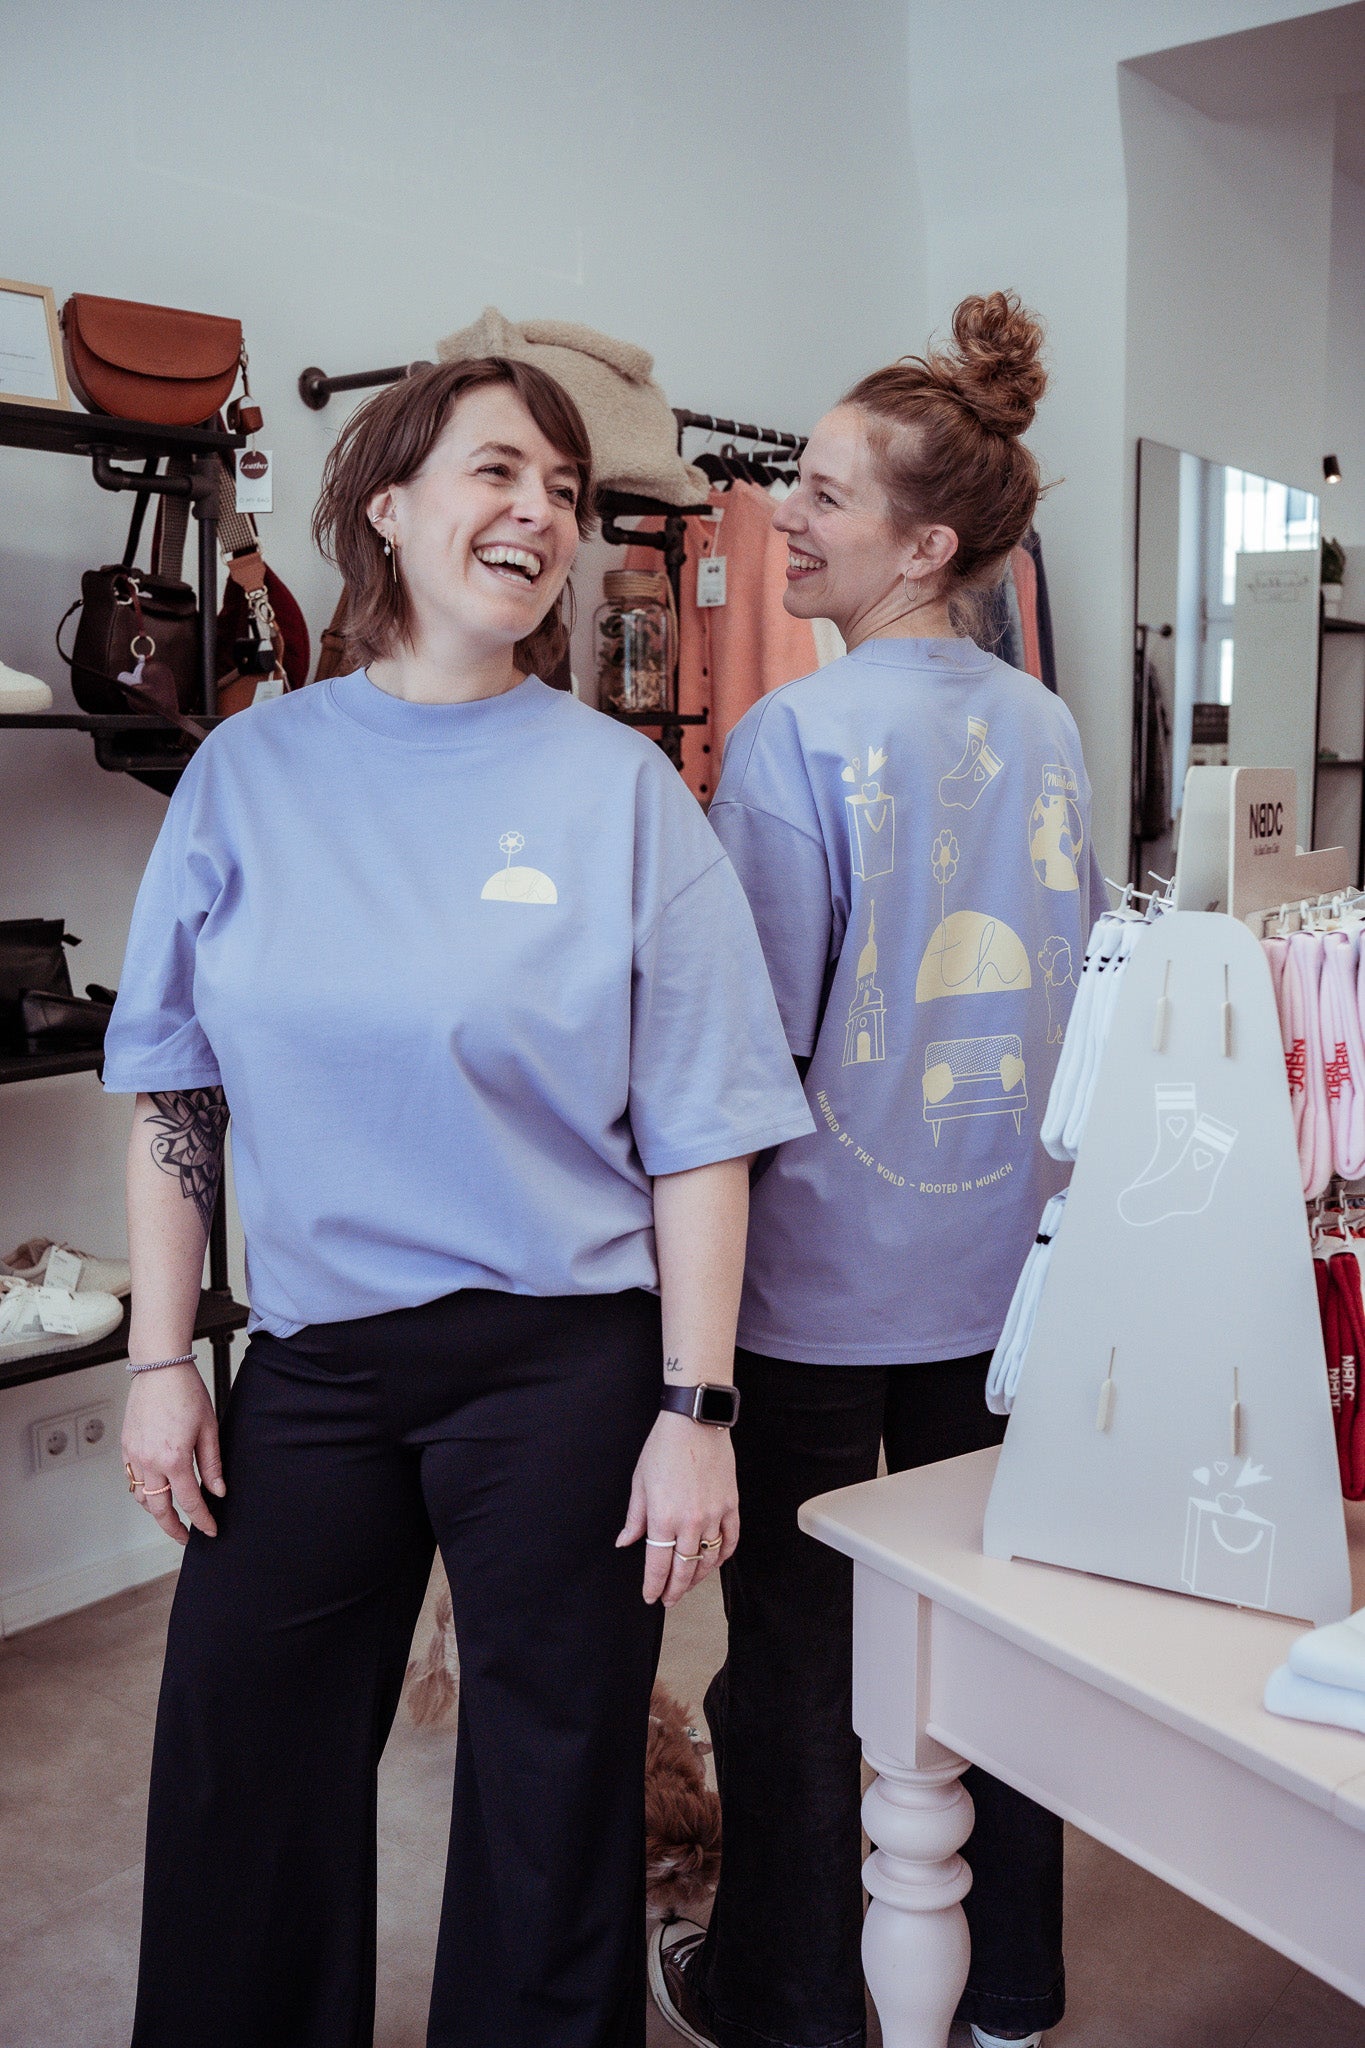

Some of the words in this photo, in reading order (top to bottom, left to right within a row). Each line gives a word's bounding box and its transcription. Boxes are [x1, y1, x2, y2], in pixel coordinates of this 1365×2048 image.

[929, 920, 1022, 988] th
[816, 1090, 840, 1132] INSPIRED
[838, 1132, 854, 1147] BY
[854, 1146, 875, 1167] THE
[877, 1162, 905, 1187] WORLD
[920, 1182, 958, 1194] ROOTED
[962, 1180, 972, 1192] IN
[976, 1162, 1014, 1189] MUNICH
[666, 1357, 683, 1371] th
